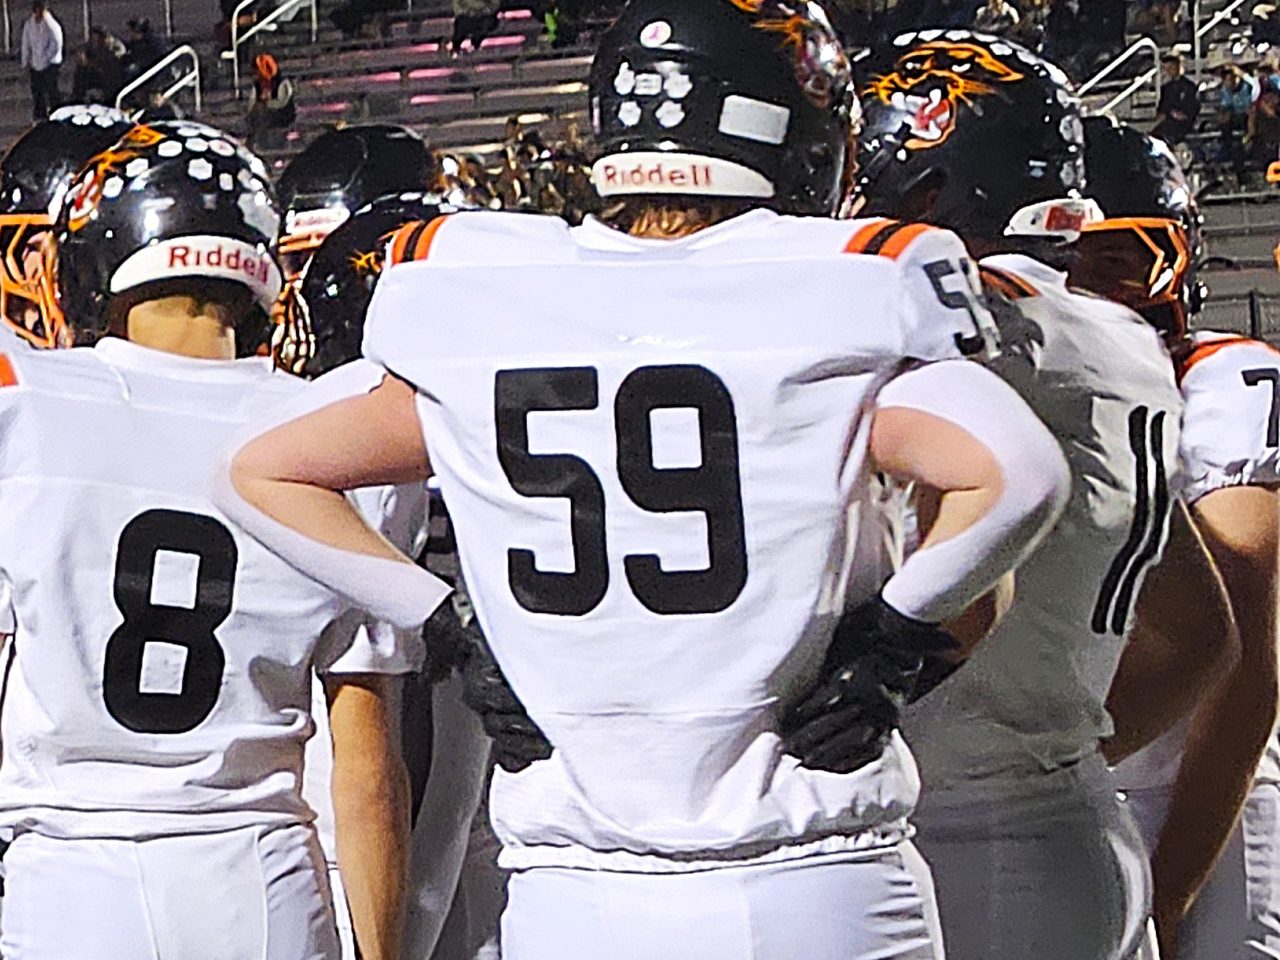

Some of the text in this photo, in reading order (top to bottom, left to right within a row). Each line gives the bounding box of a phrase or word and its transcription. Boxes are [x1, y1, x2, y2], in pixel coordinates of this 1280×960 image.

[604, 164, 711, 187] Riddell
[494, 364, 748, 616] 59
[1091, 405, 1170, 636] 11
[102, 508, 238, 734] 8
